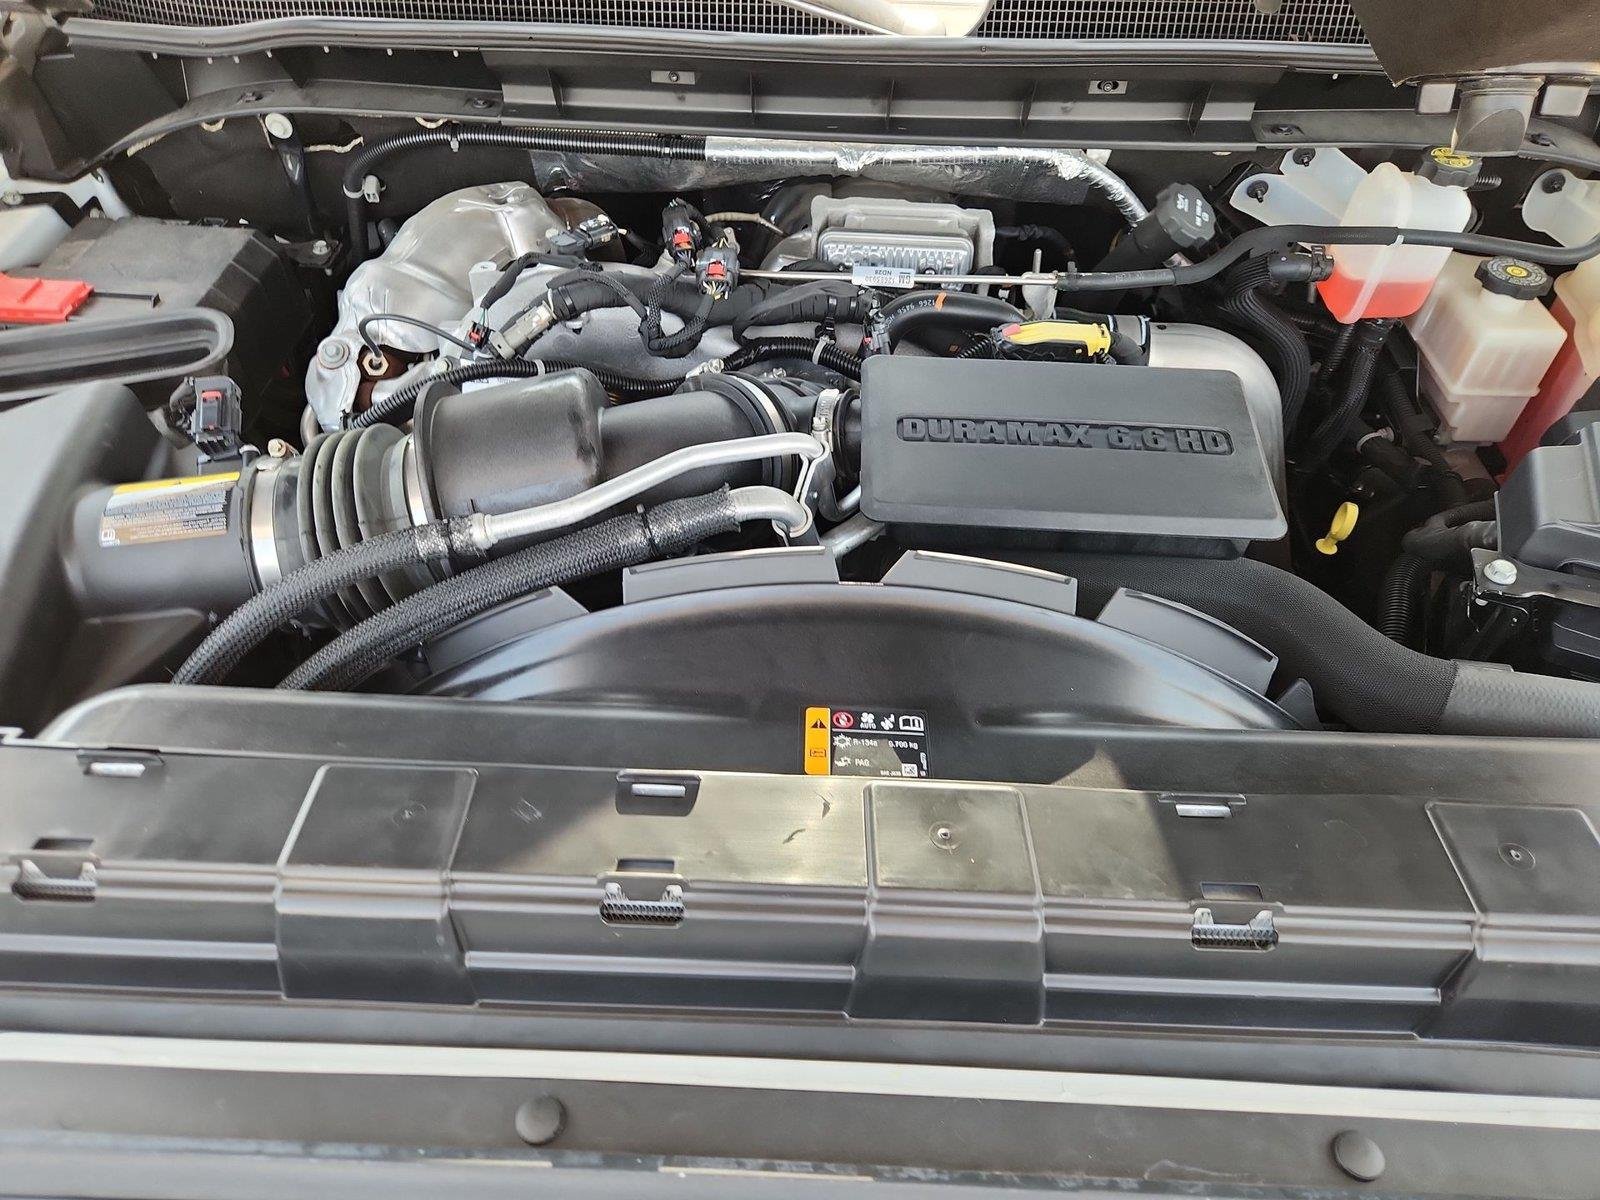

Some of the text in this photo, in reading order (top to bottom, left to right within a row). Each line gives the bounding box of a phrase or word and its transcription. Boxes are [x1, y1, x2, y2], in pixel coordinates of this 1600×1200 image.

[899, 274, 911, 284] GM
[919, 299, 935, 307] 1266
[902, 417, 1226, 454] DURAMAX 6.6 HD
